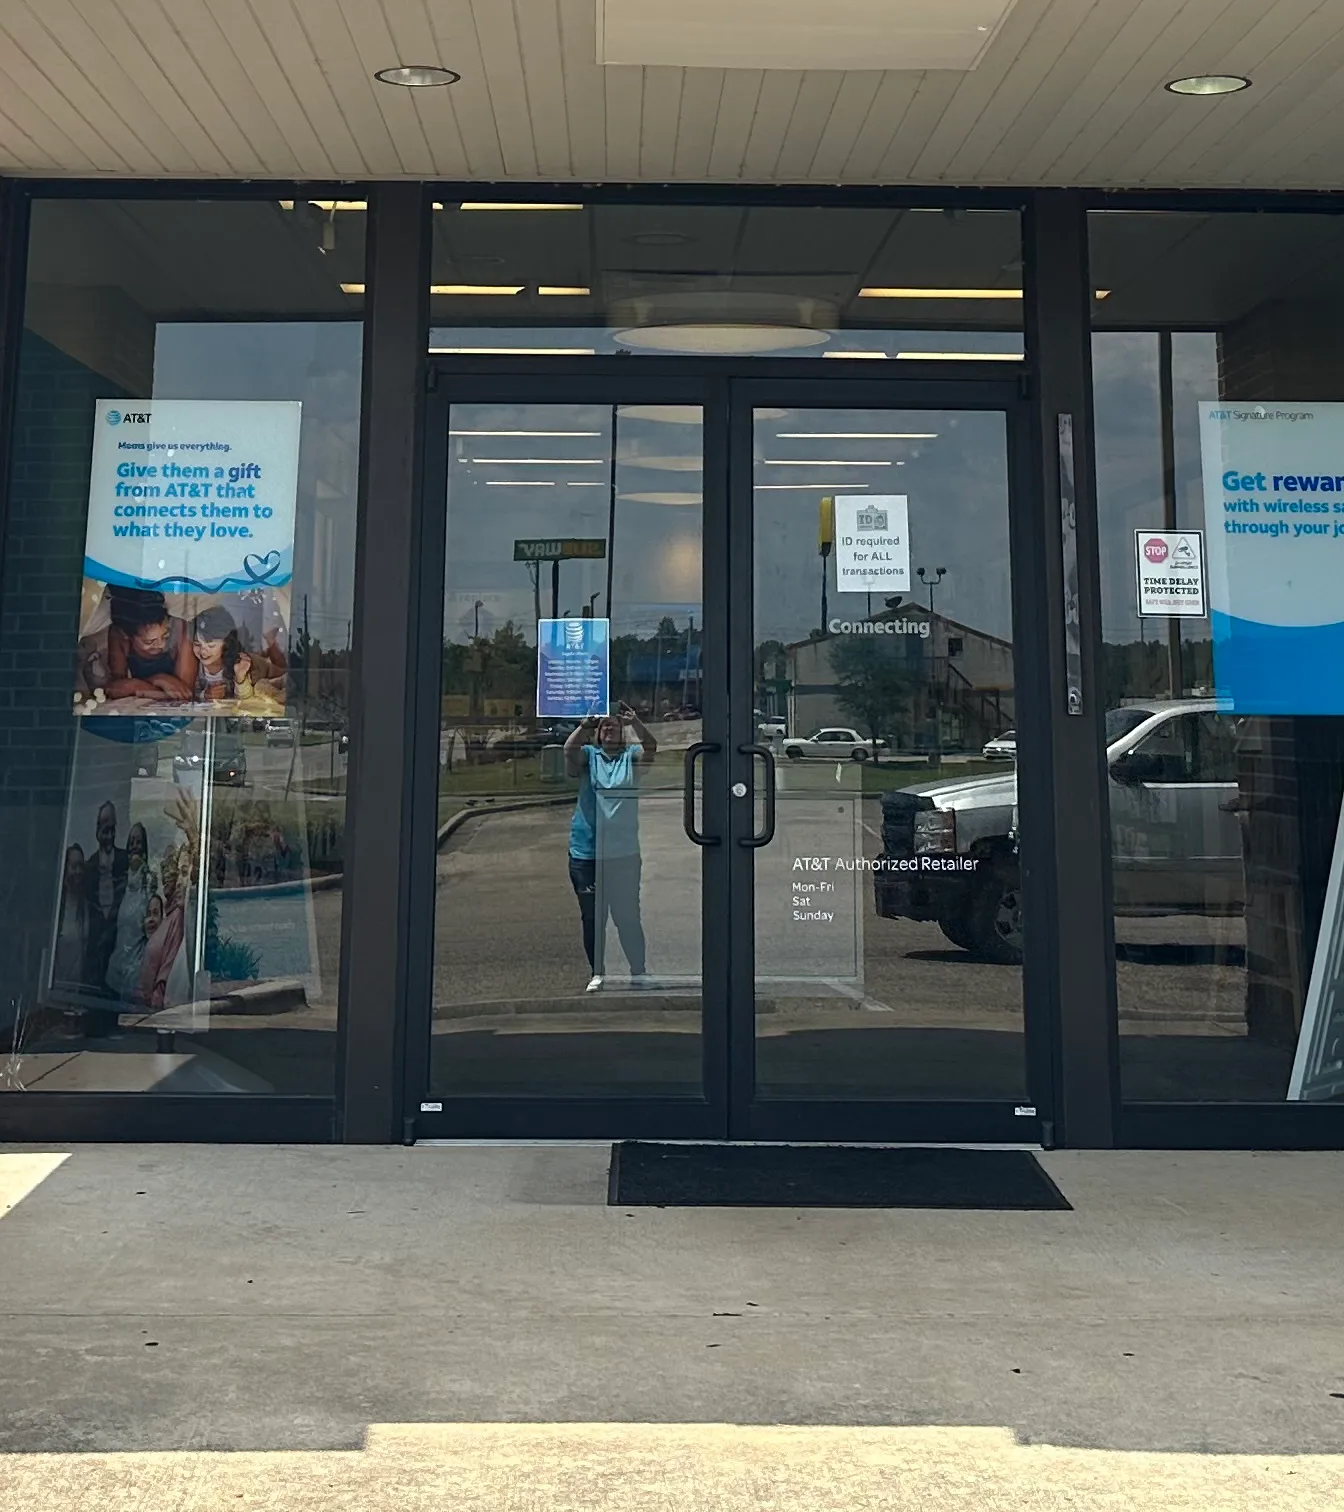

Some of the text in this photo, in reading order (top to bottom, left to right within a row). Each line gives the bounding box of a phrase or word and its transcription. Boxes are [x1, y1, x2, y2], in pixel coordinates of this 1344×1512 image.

[122, 412, 152, 424] AT&T
[1209, 410, 1314, 422] AT&T Signature Program
[146, 442, 166, 452] give
[167, 443, 179, 451] us
[180, 441, 232, 453] everything.
[116, 462, 262, 483] Give them a gift
[1222, 470, 1267, 491] Get
[114, 481, 256, 499] from AT&T that
[113, 502, 273, 519] connects them to
[1223, 498, 1259, 513] with
[1263, 498, 1329, 514] wireless
[113, 522, 254, 542] what they love.
[1224, 520, 1289, 538] through
[1293, 524, 1330, 538] your
[841, 536, 900, 548] ID required
[853, 552, 893, 561] for ALL
[1145, 546, 1167, 556] STOP
[842, 567, 905, 576] transactions
[1169, 578, 1199, 586] DELAY
[1144, 587, 1199, 595] PROTECTED
[828, 618, 931, 638] Connecting
[792, 856, 979, 871] AT&T Authorized Retailer
[792, 882, 835, 892] Mon-Fri
[792, 896, 811, 906] Sat
[793, 910, 834, 922] Sunday
